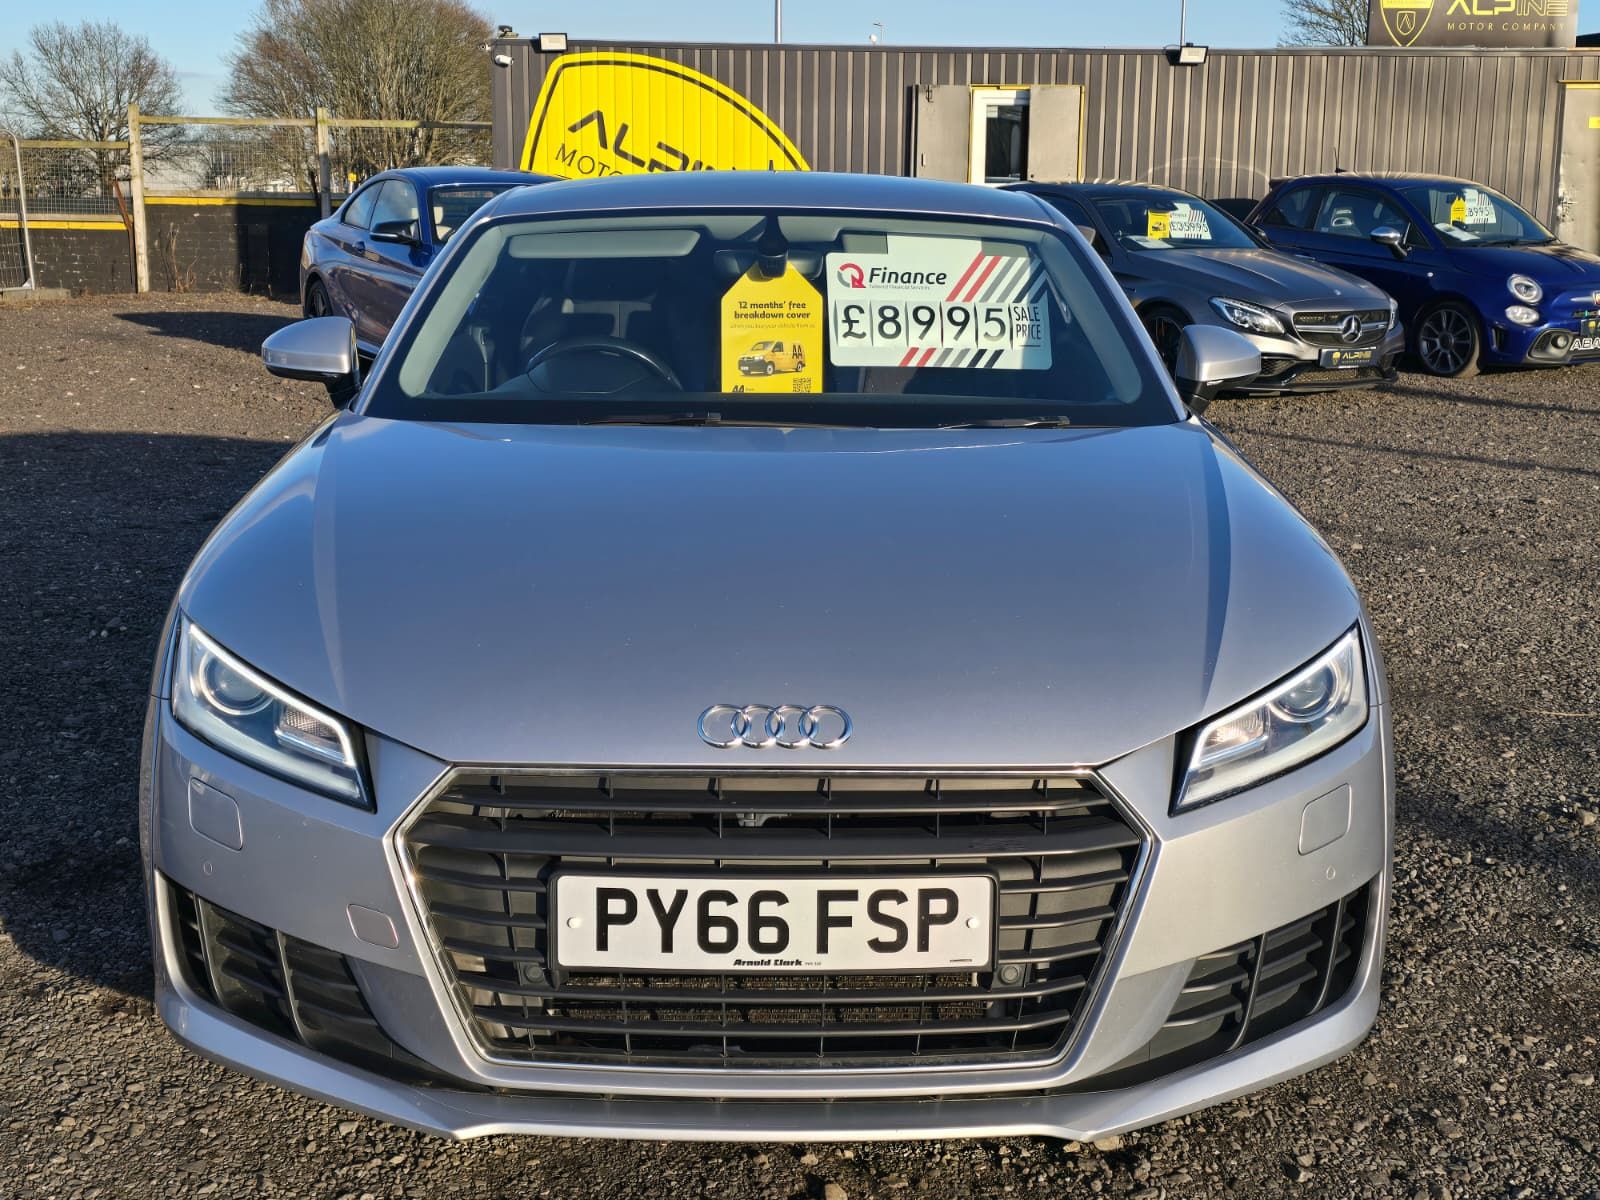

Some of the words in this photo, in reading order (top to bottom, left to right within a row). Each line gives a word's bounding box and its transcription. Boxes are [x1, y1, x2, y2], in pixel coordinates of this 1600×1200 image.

[1447, 22, 1494, 31] MOTOR
[1502, 22, 1566, 31] COMPANY
[868, 266, 948, 285] Finance
[738, 301, 748, 309] 12
[788, 301, 806, 310] free
[734, 311, 784, 319] breakdown
[1013, 306, 1041, 322] SALE
[841, 304, 1007, 342] £8995
[1015, 324, 1041, 340] PRICE
[791, 344, 803, 360] AA
[595, 886, 791, 954] PY66
[815, 886, 960, 954] FSP
[732, 958, 771, 966] Arnold
[773, 958, 803, 967] Clark
